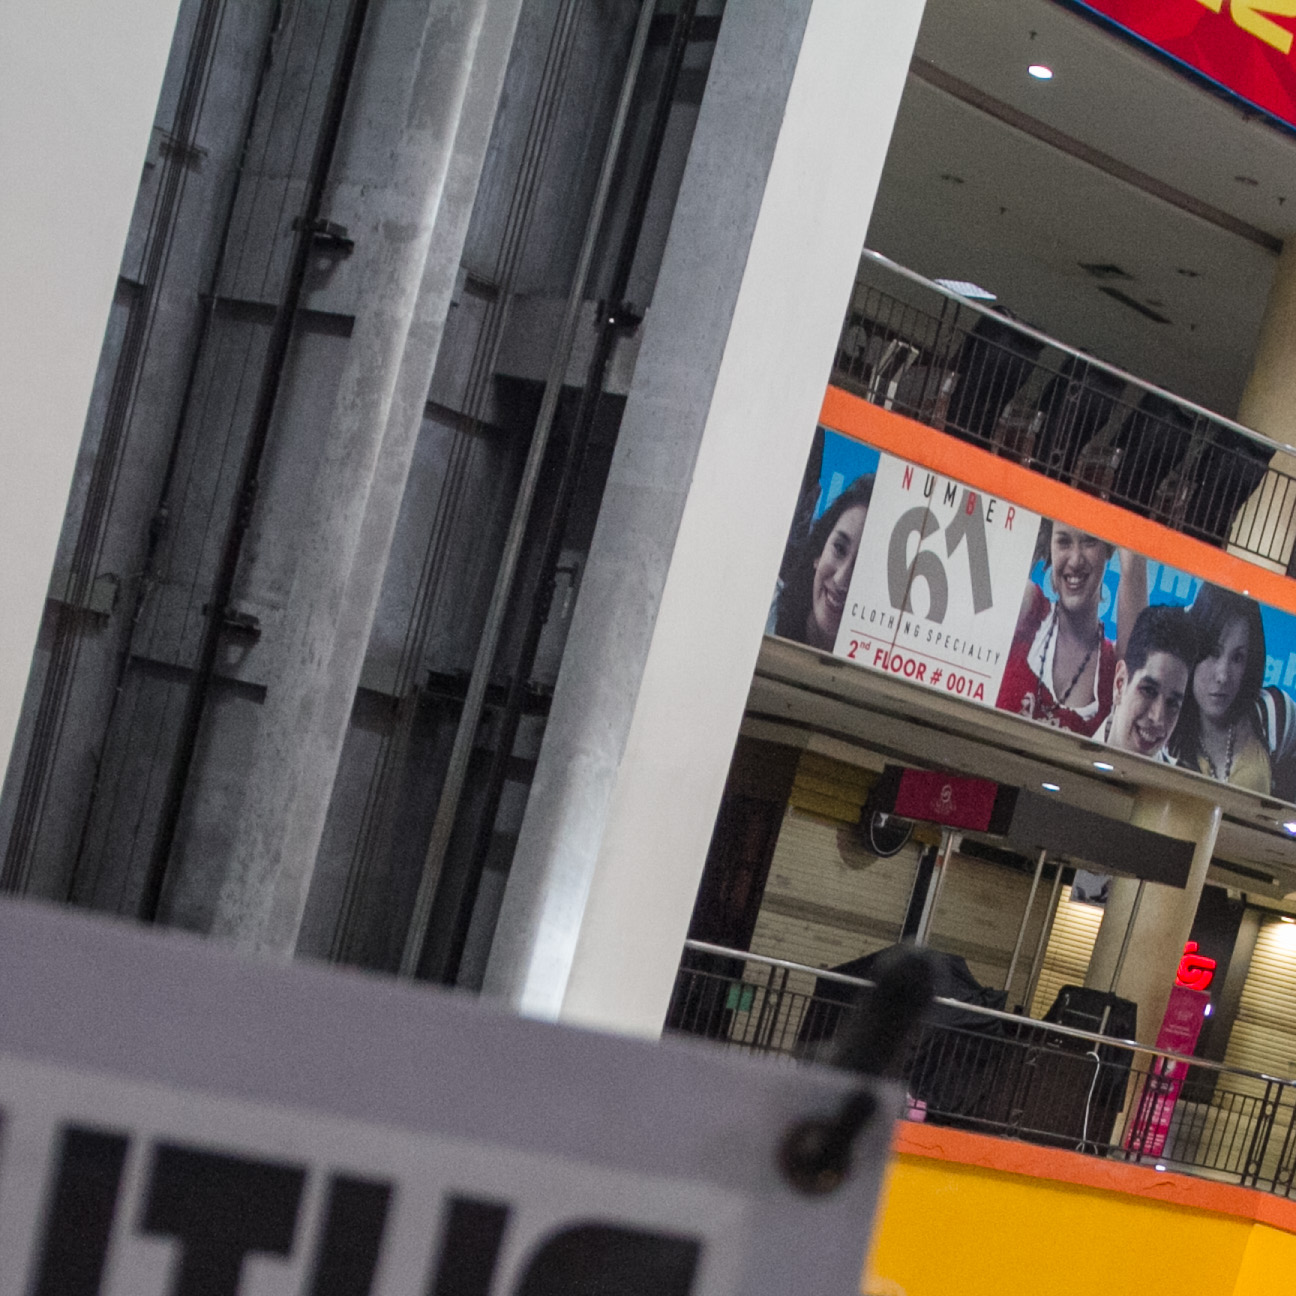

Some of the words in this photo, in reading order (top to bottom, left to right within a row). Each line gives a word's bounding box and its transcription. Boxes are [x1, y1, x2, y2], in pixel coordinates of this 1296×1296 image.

[901, 465, 1016, 531] NUMBER
[887, 488, 993, 625] 61
[851, 603, 920, 638] CLOTHING
[926, 629, 1001, 666] SPECIALTY
[847, 640, 871, 660] 2nd
[872, 647, 927, 682] FLOOR
[946, 673, 985, 702] 001A
